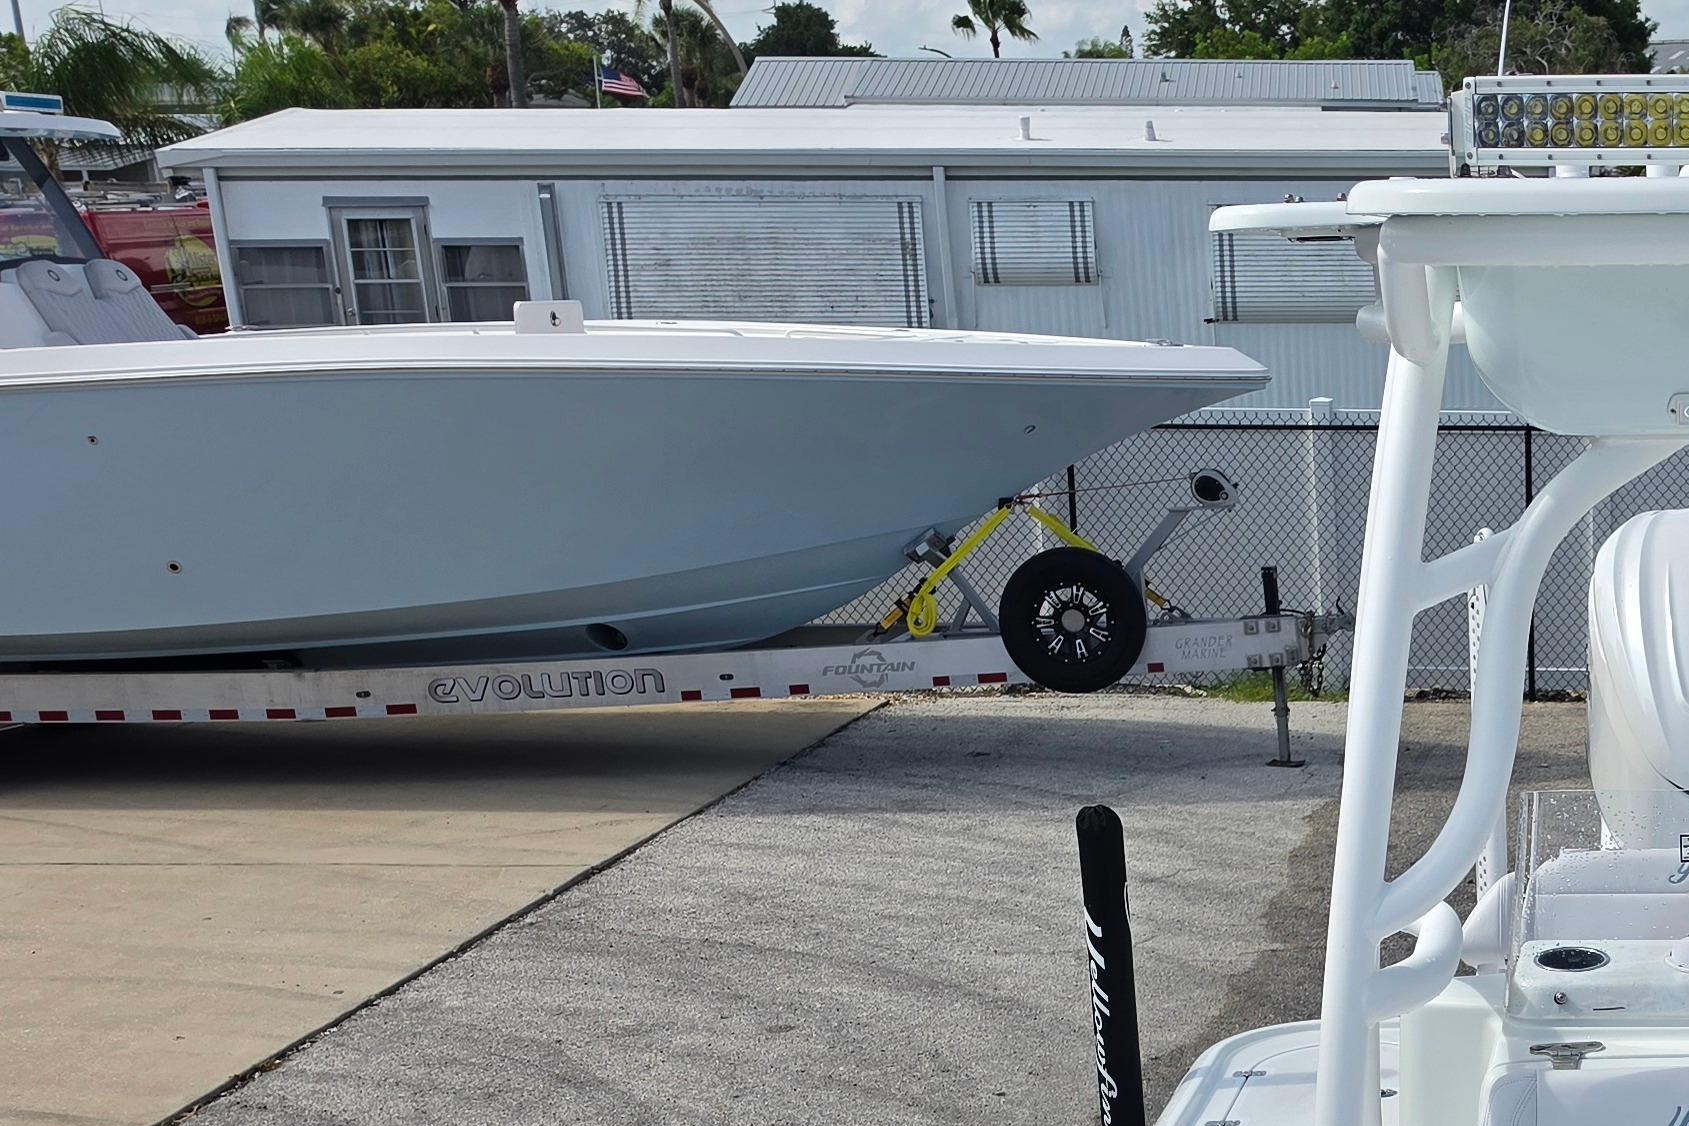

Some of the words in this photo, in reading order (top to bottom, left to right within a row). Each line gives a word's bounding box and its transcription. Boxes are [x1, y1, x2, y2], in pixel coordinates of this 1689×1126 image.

[1174, 634, 1234, 650] GRANDER
[1181, 646, 1227, 660] MARINE
[821, 660, 916, 677] FOUNTAIN
